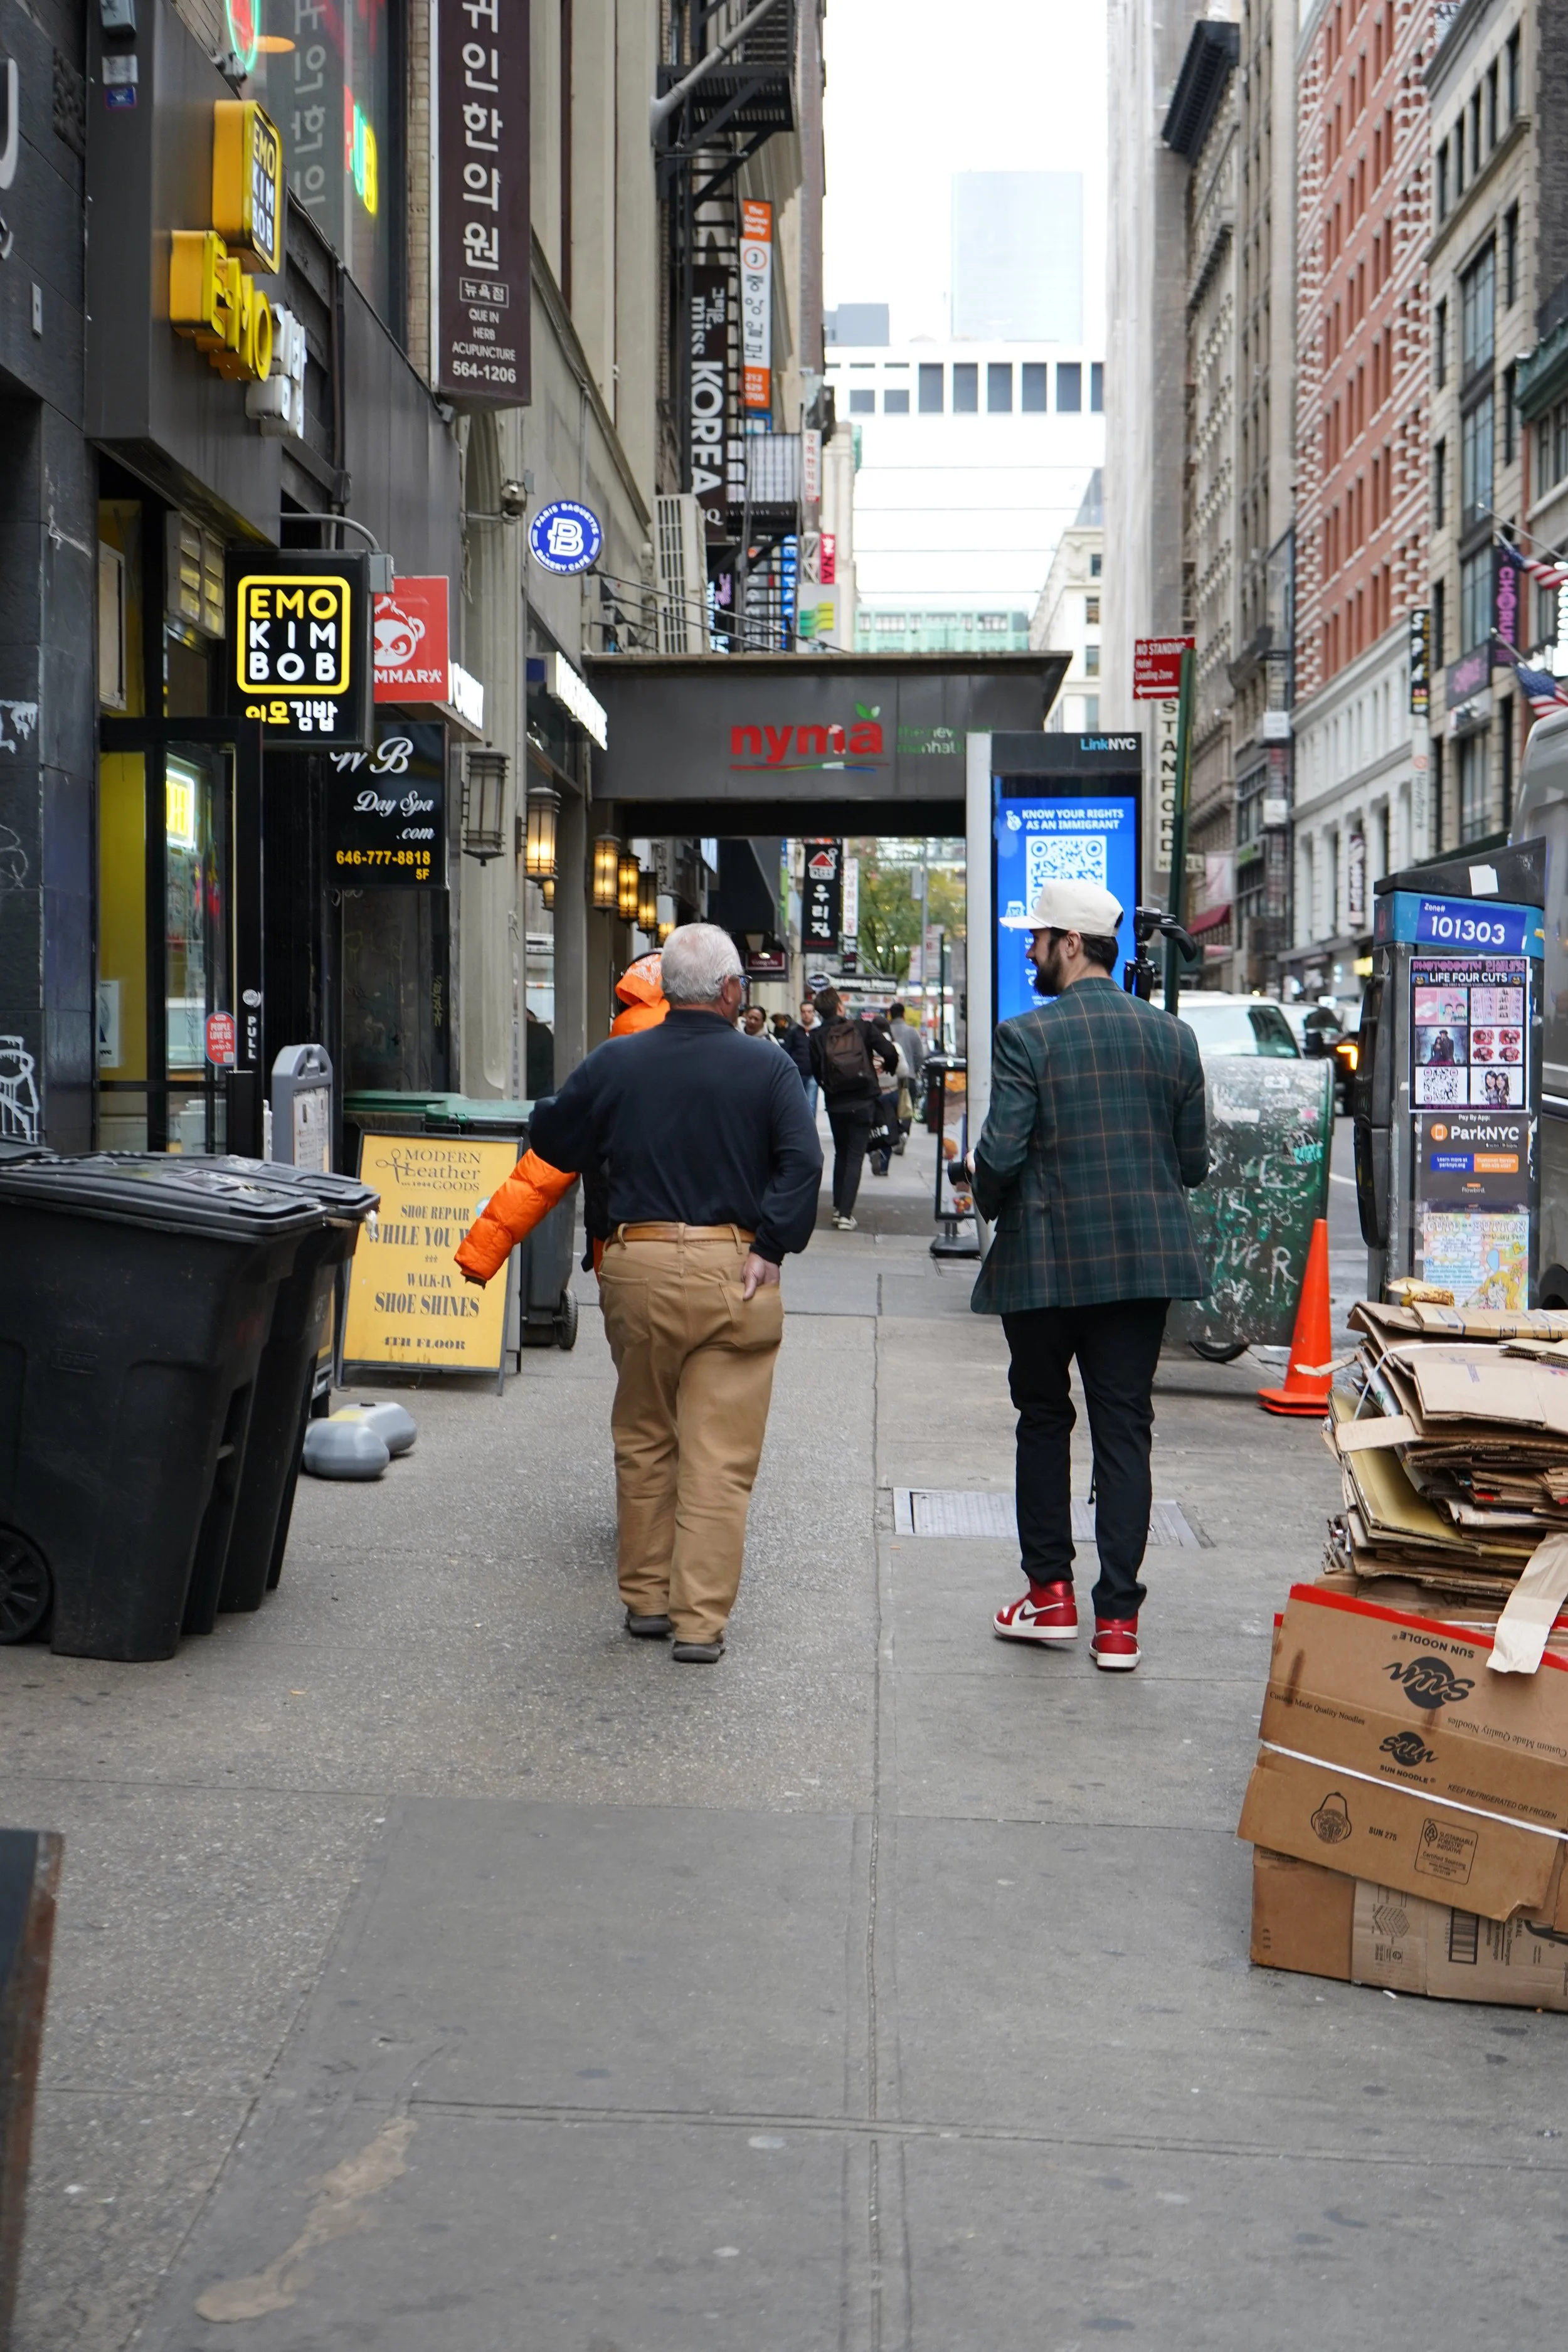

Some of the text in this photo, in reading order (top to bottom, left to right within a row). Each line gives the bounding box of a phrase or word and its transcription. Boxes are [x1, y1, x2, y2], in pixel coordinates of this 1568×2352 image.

[254, 120, 275, 179] EMO
[253, 159, 275, 218] KIM
[252, 196, 273, 252] BOB
[469, 308, 499, 324] QUE IN
[472, 326, 495, 341] HERB
[452, 341, 516, 361] ACUPUNCTURE
[452, 360, 516, 384] 564-1206
[691, 361, 724, 495] KOREA
[535, 502, 599, 534] PARIS BAGUETTE
[536, 549, 567, 571] BAKERY
[250, 588, 338, 620] EMO
[250, 620, 336, 649] KIM
[250, 651, 336, 682] BOB
[245, 701, 338, 732] 이모김밥
[730, 721, 884, 764] nyma
[1080, 738, 1136, 751] LinkNYC
[369, 736, 414, 773] B
[1162, 701, 1177, 852] STANFORD
[354, 790, 434, 817] Day Spa
[1022, 809, 1124, 819] KNOW YOUR RIGHTS
[1026, 820, 1120, 830] AS AN IMMIGRANT
[336, 850, 431, 866] 646-777-8818
[415, 868, 430, 881] 5F
[1424, 903, 1446, 913] Zone#
[1432, 916, 1505, 945] 101303
[1429, 972, 1508, 983] LIFE FOUR CUTS
[209, 1030, 231, 1040] LOVE US
[210, 1022, 230, 1032] PEOPLE
[247, 1015, 257, 1059] PULL
[1451, 1125, 1520, 1141] ParkNYC
[405, 1148, 482, 1164] MODERN
[403, 1163, 480, 1180] Leather
[433, 1180, 480, 1192] GOODS
[401, 1205, 469, 1222] SHOE REPAIR
[424, 1227, 454, 1248] YOU
[407, 1273, 452, 1288] WALK-IN
[374, 1292, 480, 1317] SHOE SHINES
[384, 1337, 465, 1350] 4TH FLOOR
[1399, 1631, 1475, 1659] SUN NOODLE
[1295, 1698, 1312, 1710] Made
[1314, 1705, 1337, 1719] Quality
[1338, 1712, 1365, 1725] Noodles
[1448, 1717, 1567, 1757] Custom Made Quality Noodles
[1380, 1765, 1428, 1784] SUN NOODLE
[1448, 1784, 1557, 1820] KEEP REFRIGERATED OR FROZEN
[1369, 1826, 1397, 1841] SUN 275
[1439, 1831, 1474, 1846] SUSTAINABLE
[1436, 1843, 1462, 1855] INITIATIVE
[1438, 1838, 1464, 1850] FORESTRY
[1422, 1850, 1466, 1869] Certified Sourcing
